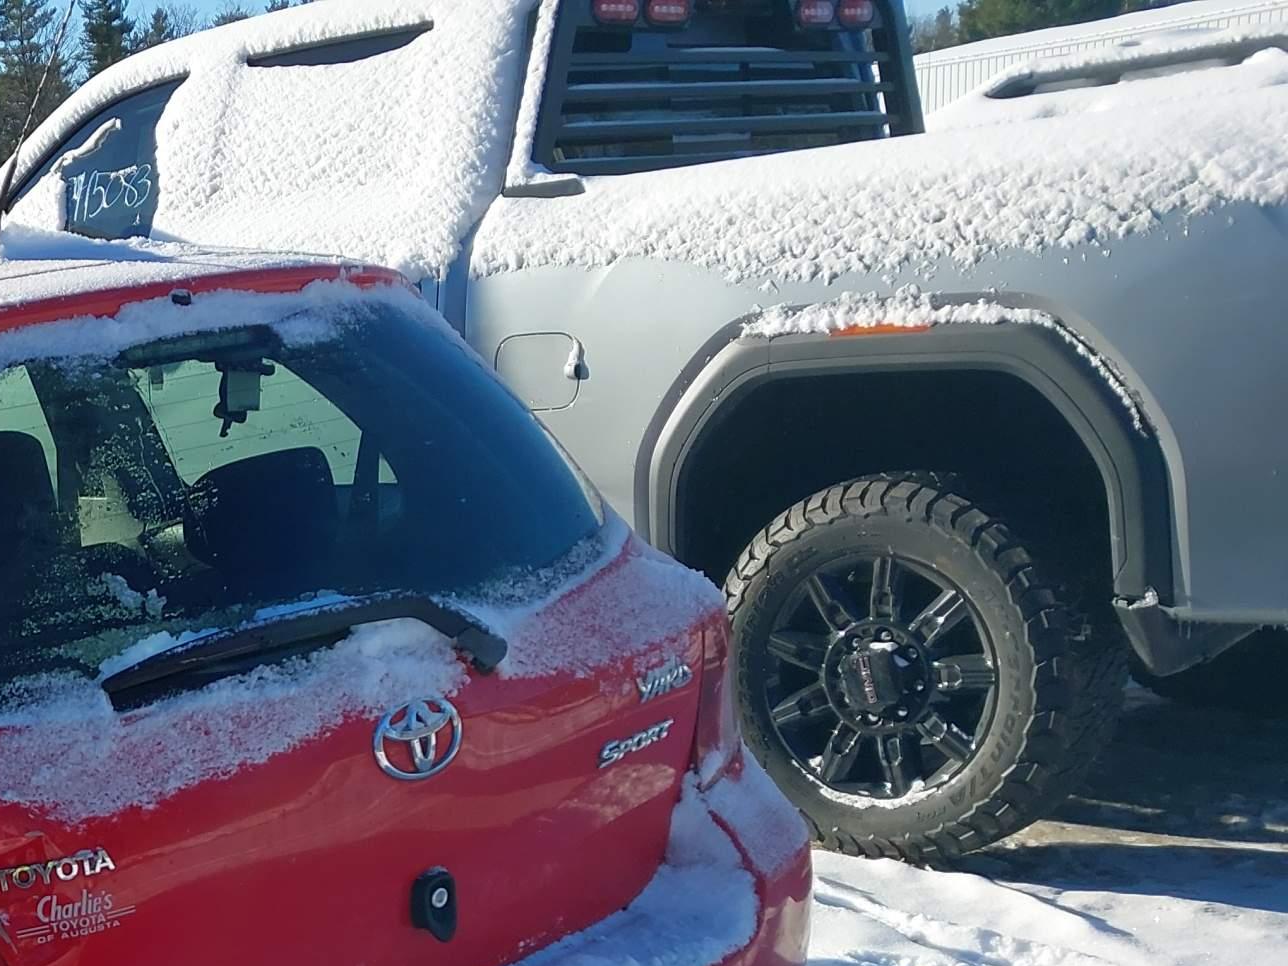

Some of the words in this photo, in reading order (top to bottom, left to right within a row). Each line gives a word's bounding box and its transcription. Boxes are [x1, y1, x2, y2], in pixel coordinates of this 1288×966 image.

[37, 889, 113, 923] Charlie's
[37, 935, 55, 944] OF
[61, 920, 121, 939] AUGUSTA
[50, 912, 106, 933] TOYOTA
